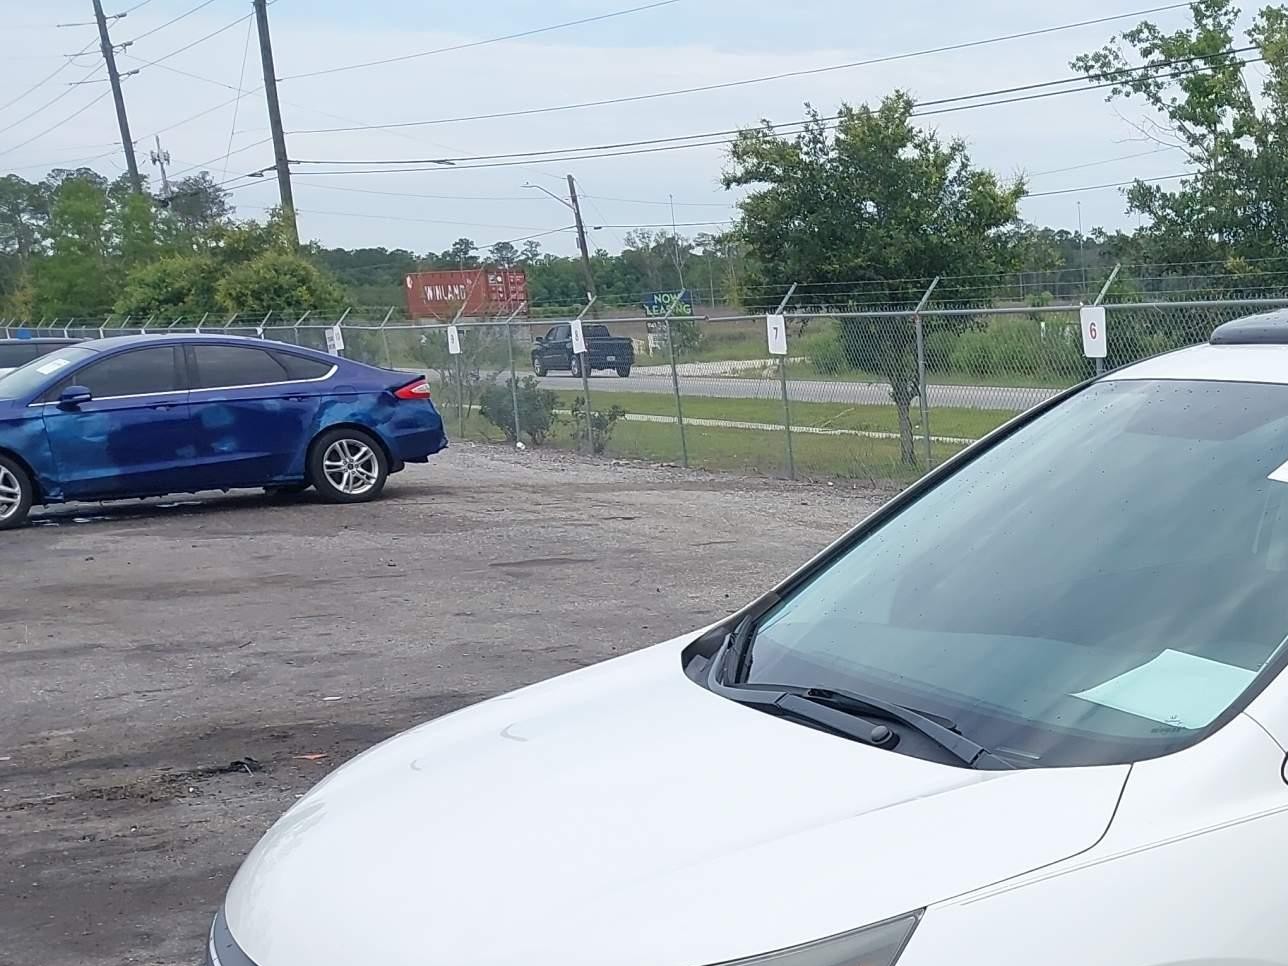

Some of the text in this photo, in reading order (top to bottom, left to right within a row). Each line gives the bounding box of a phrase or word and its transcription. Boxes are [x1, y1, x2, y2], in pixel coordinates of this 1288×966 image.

[653, 293, 681, 304] NOW
[772, 326, 780, 341] 7
[1088, 321, 1097, 340] 6
